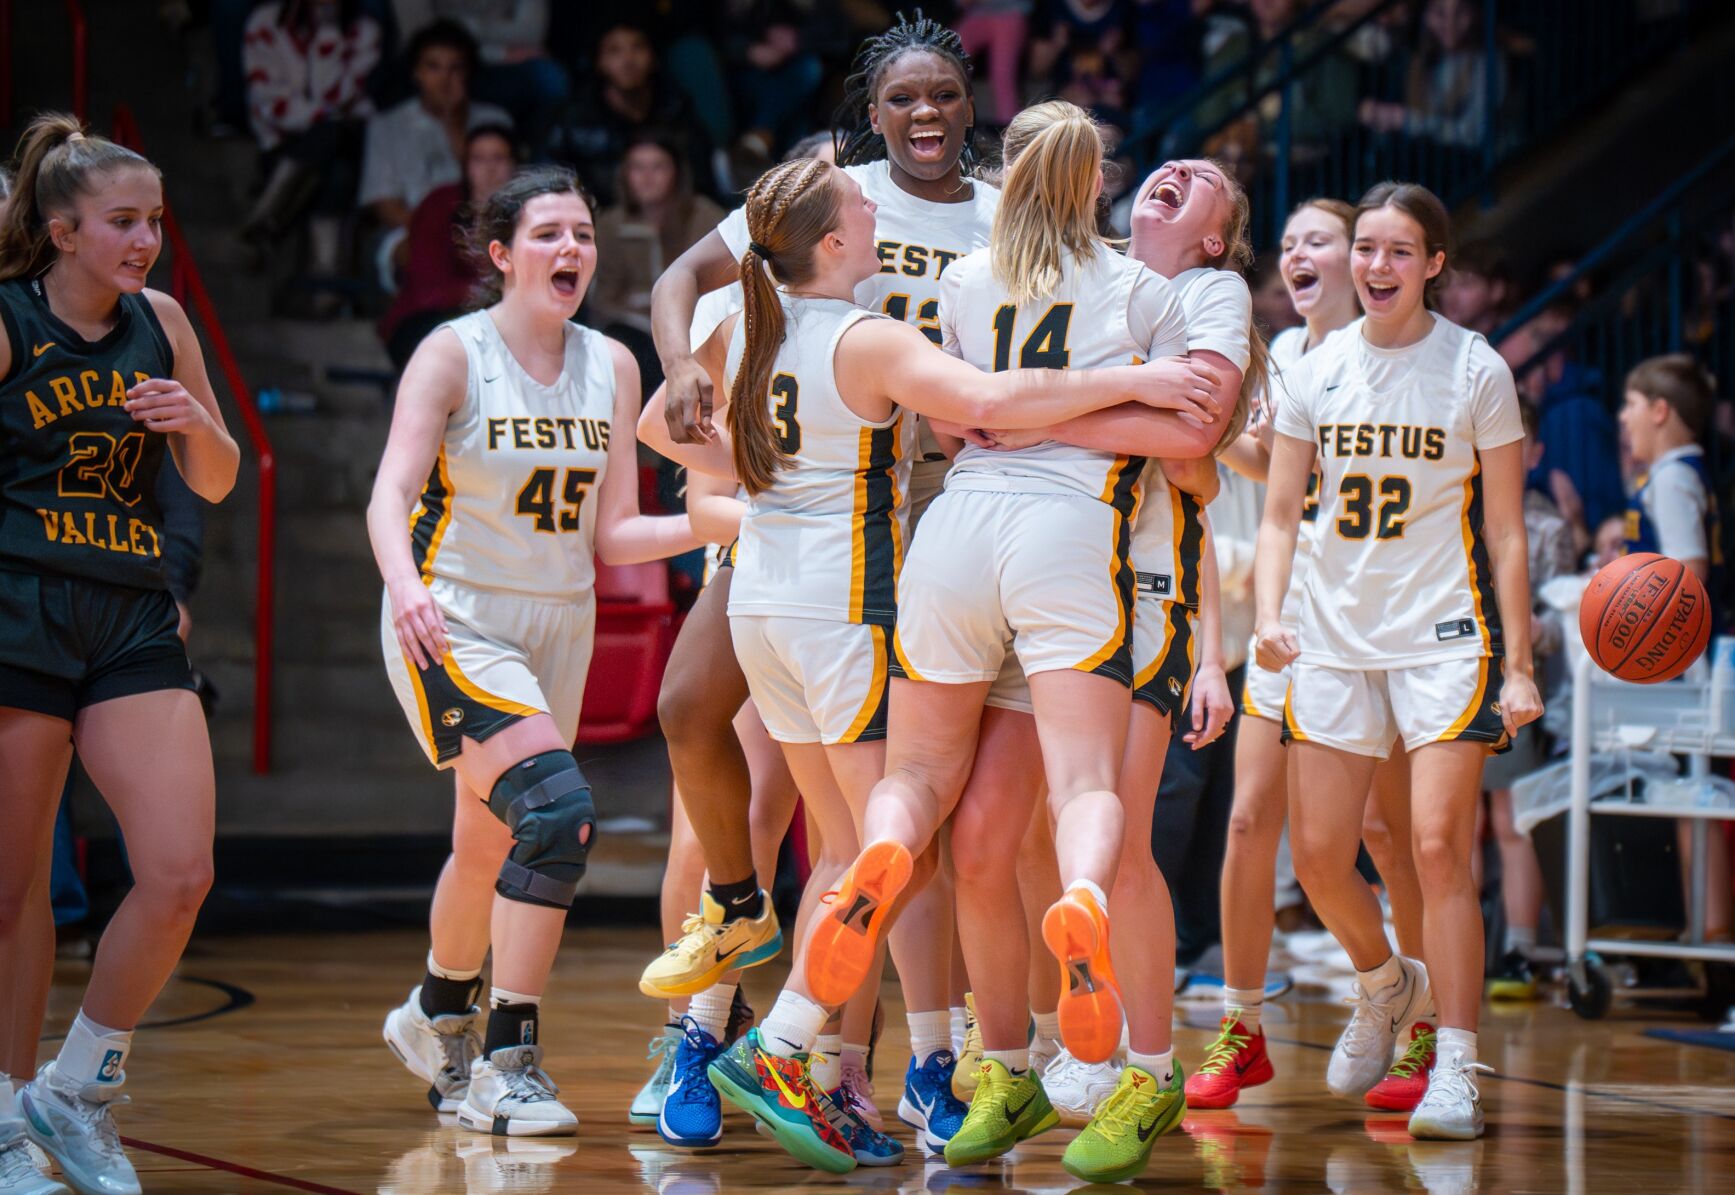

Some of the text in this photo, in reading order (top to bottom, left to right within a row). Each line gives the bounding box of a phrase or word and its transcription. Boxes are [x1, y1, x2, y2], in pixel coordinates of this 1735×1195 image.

[876, 240, 968, 281] EST
[992, 302, 1074, 372] 14
[487, 416, 611, 452] FESTUS
[1318, 422, 1446, 461] FESTUS
[515, 466, 598, 534] 45
[1335, 473, 1412, 541] 32
[1157, 580, 1166, 589] M
[1635, 587, 1697, 671] SPALDING
